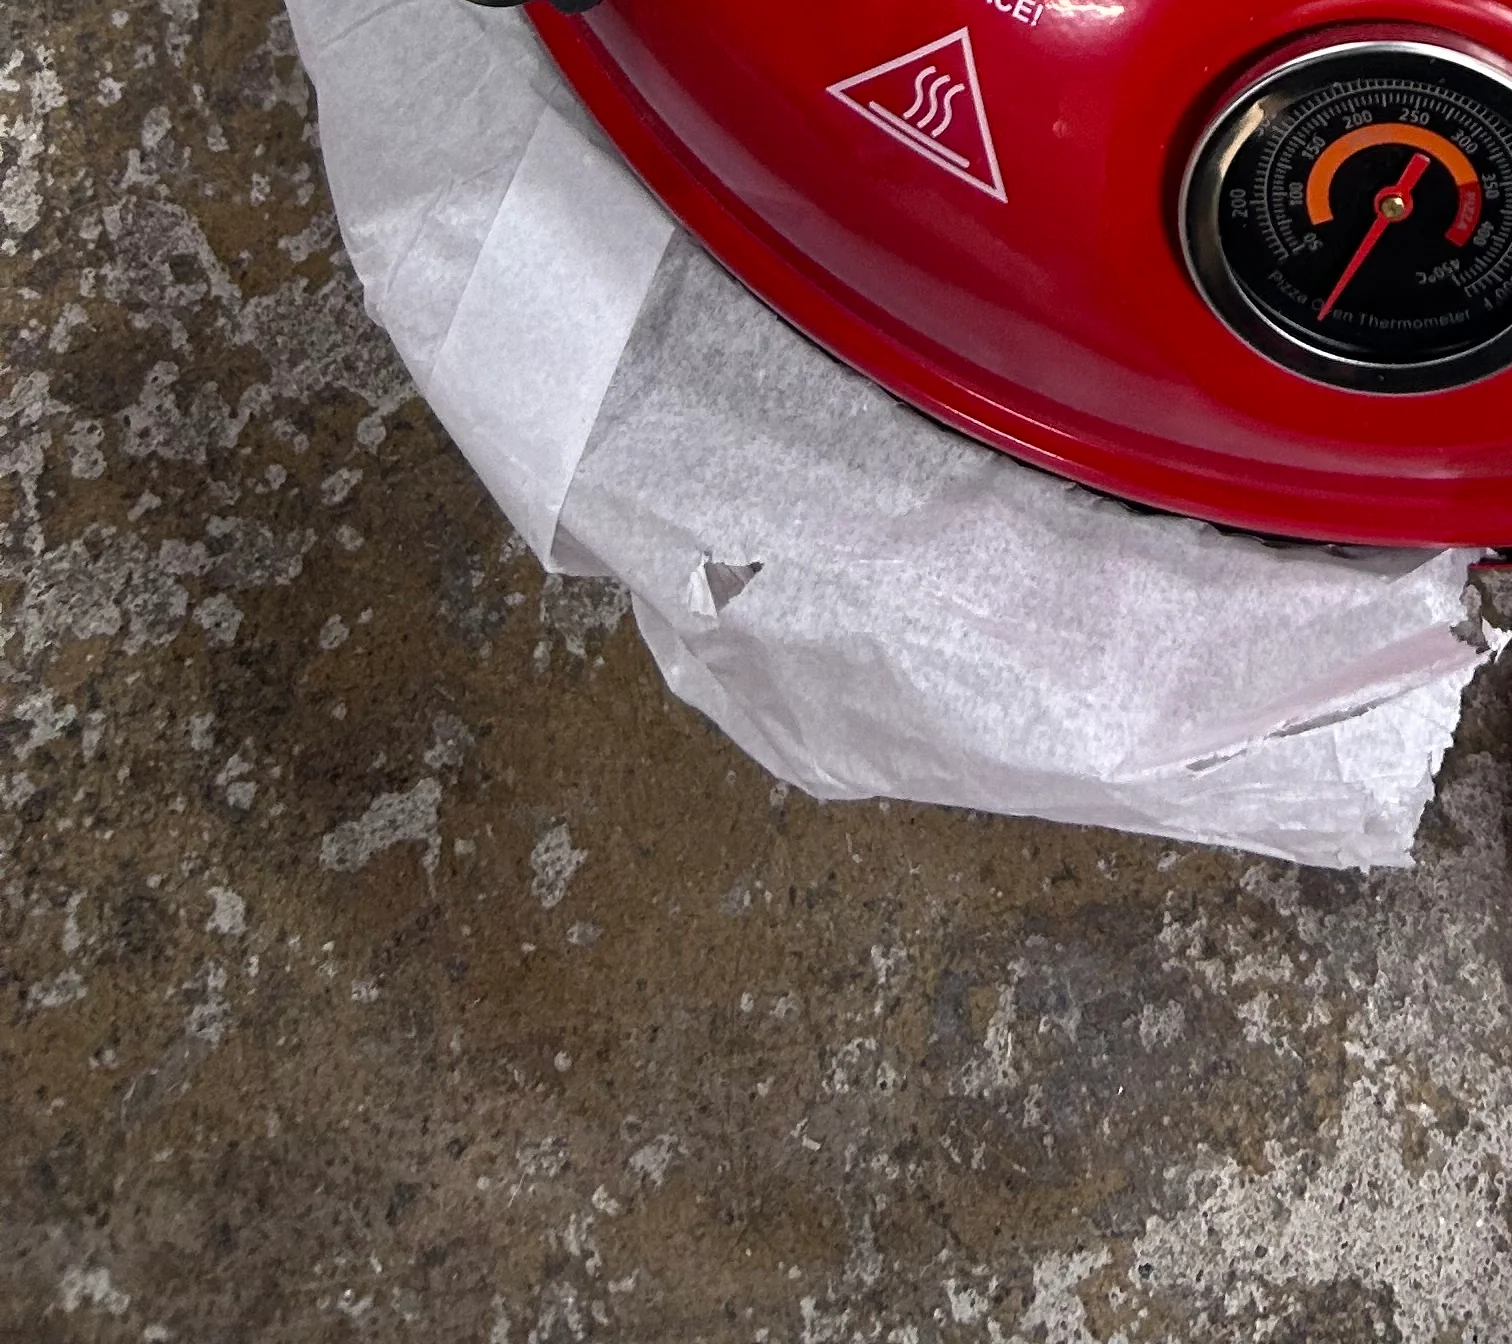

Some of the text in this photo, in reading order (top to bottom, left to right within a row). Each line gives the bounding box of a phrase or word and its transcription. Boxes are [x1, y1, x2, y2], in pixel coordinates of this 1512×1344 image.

[1341, 109, 1373, 130] 200
[1398, 107, 1431, 126] 250
[1301, 134, 1327, 161] 150
[1450, 128, 1479, 155] 300
[1288, 181, 1304, 205] 100
[1481, 172, 1501, 200] 350
[1229, 187, 1249, 219] 200
[1311, 297, 1354, 324] Oen
